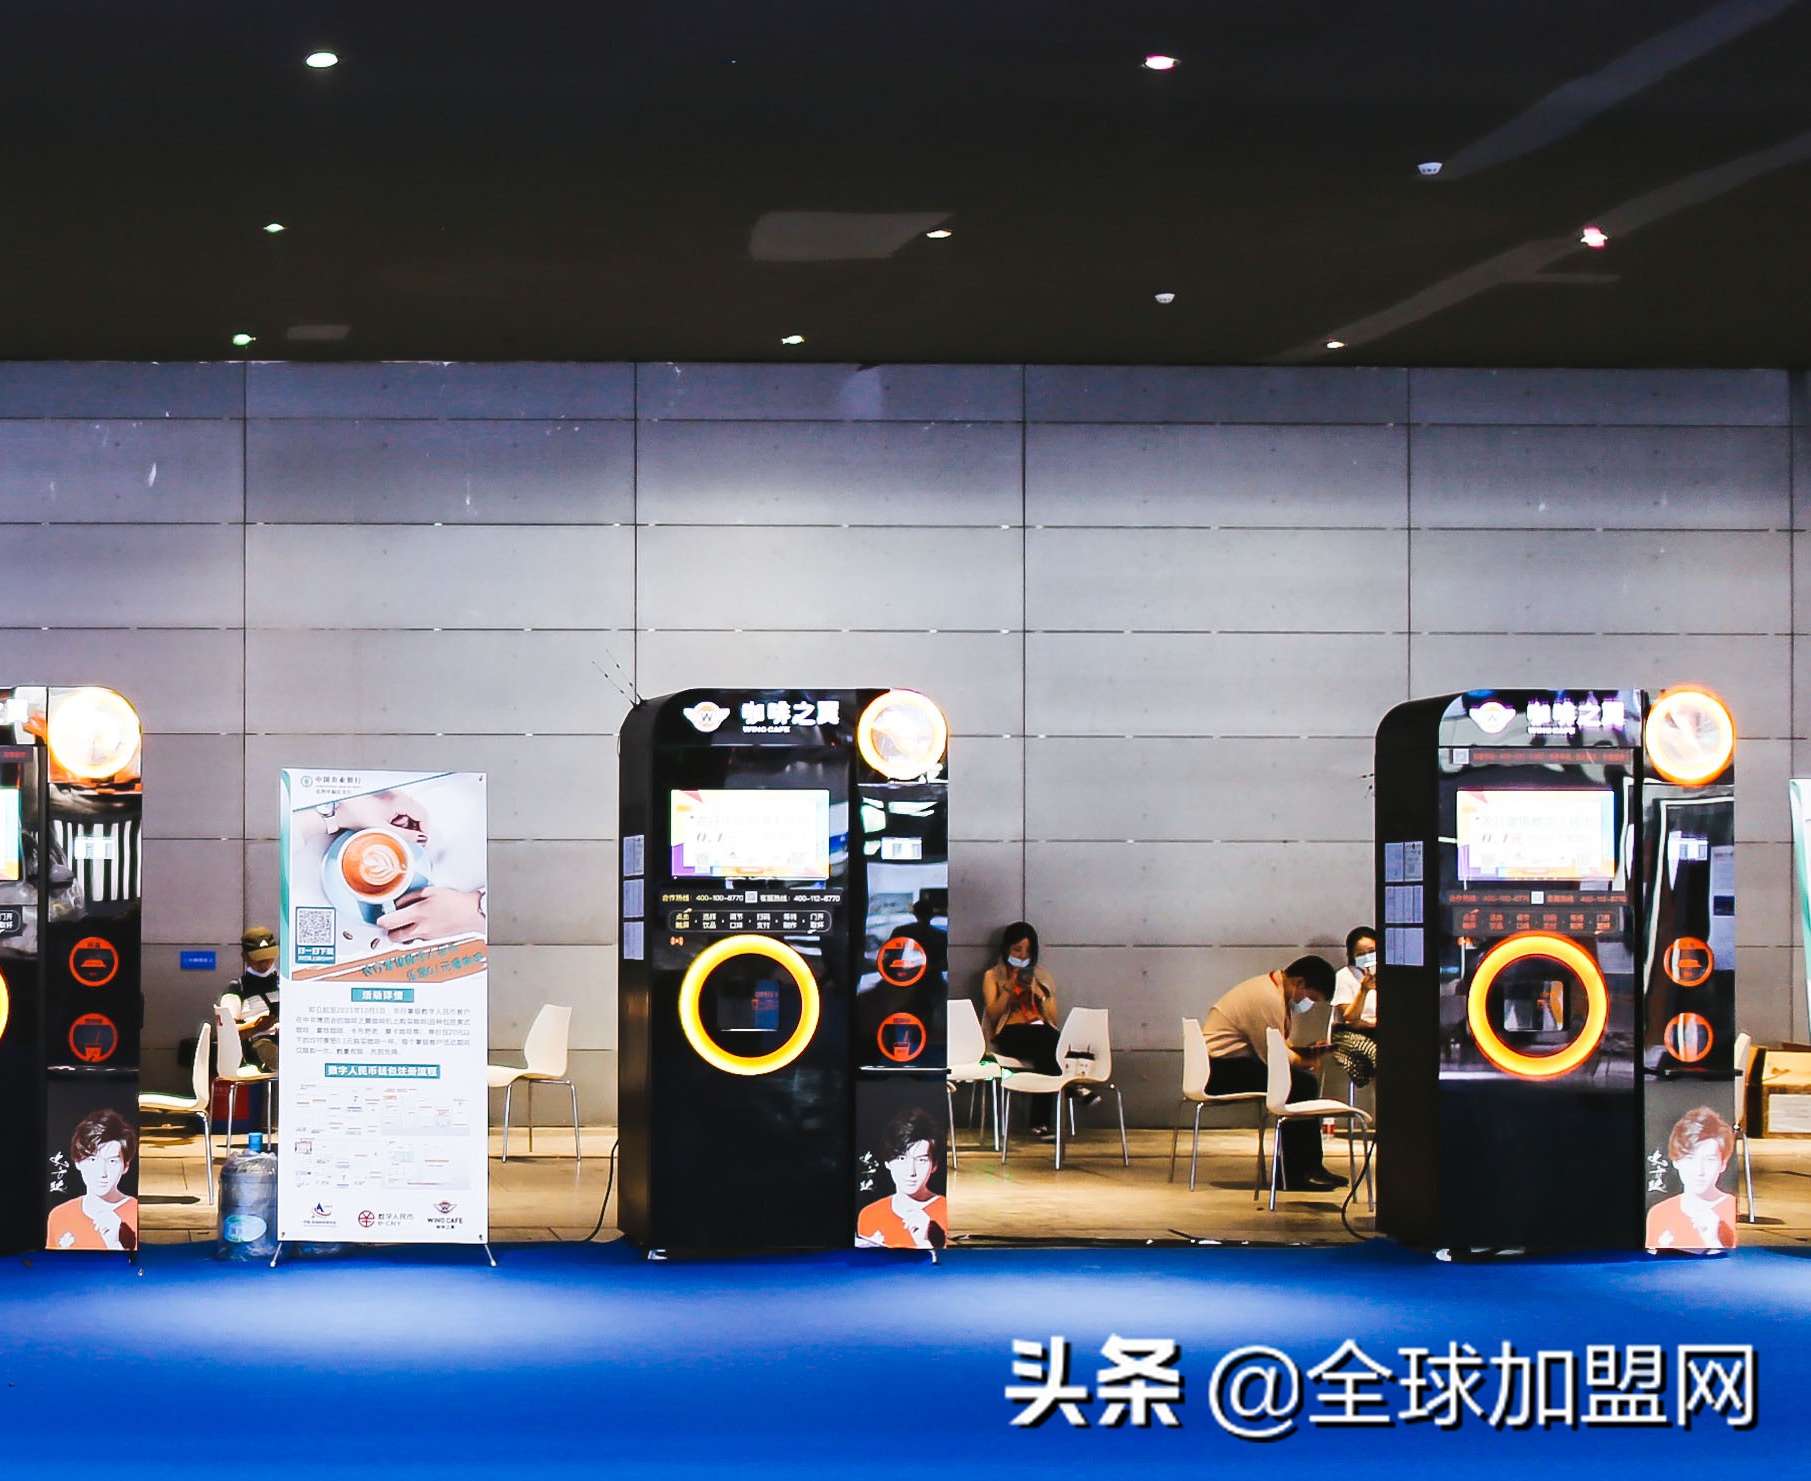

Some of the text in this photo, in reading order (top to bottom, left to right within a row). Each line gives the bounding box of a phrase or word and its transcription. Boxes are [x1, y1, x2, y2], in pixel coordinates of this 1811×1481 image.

[741, 700, 840, 725] 咖啡之翼
[810, 913, 824, 921] 门开
[361, 990, 404, 1000] 活动详情
